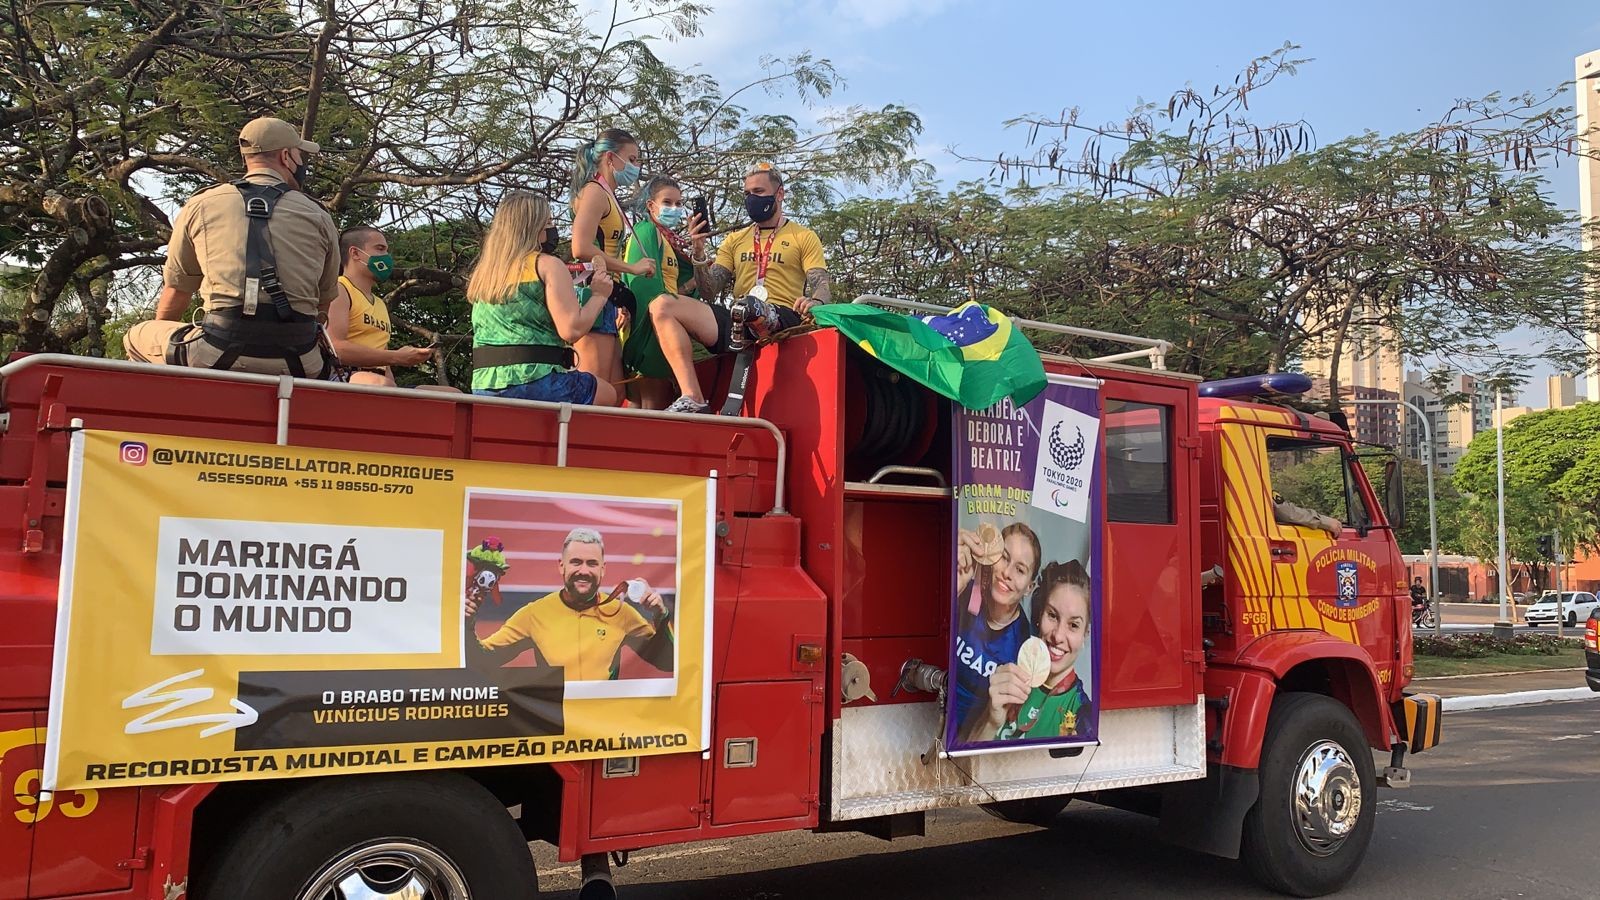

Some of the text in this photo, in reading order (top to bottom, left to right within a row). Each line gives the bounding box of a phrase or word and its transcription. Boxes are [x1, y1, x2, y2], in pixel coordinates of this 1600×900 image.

[740, 252, 785, 265] BRSIL
[968, 420, 1024, 447] DEBORA E
[152, 447, 454, 482] @VINICIUSBELLATOR.RODRIGUES
[971, 446, 1021, 472] BEATRIZ
[197, 471, 288, 487] ASSESSORIA
[294, 478, 318, 489] +55
[321, 479, 333, 490] 11
[1043, 466, 1083, 488] TOKYO 2020
[953, 483, 1032, 504] E FORAM DOIS
[967, 499, 1017, 517] BRONZES
[178, 538, 360, 571] MARINGÁ
[1315, 548, 1377, 573] POLÍCIA MILITAR
[176, 571, 407, 602] DOMINANDO
[173, 604, 352, 633] O MUNDO
[1317, 597, 1380, 621] CORPO DE BOMBEIROS
[322, 686, 499, 705] O BRABO TEM NOME
[313, 703, 509, 724] VINÍCIUS RODRIGUES
[85, 732, 687, 781] RECORDISTA MUNDIAL E CAMPEÃO PARALÍMPICO
